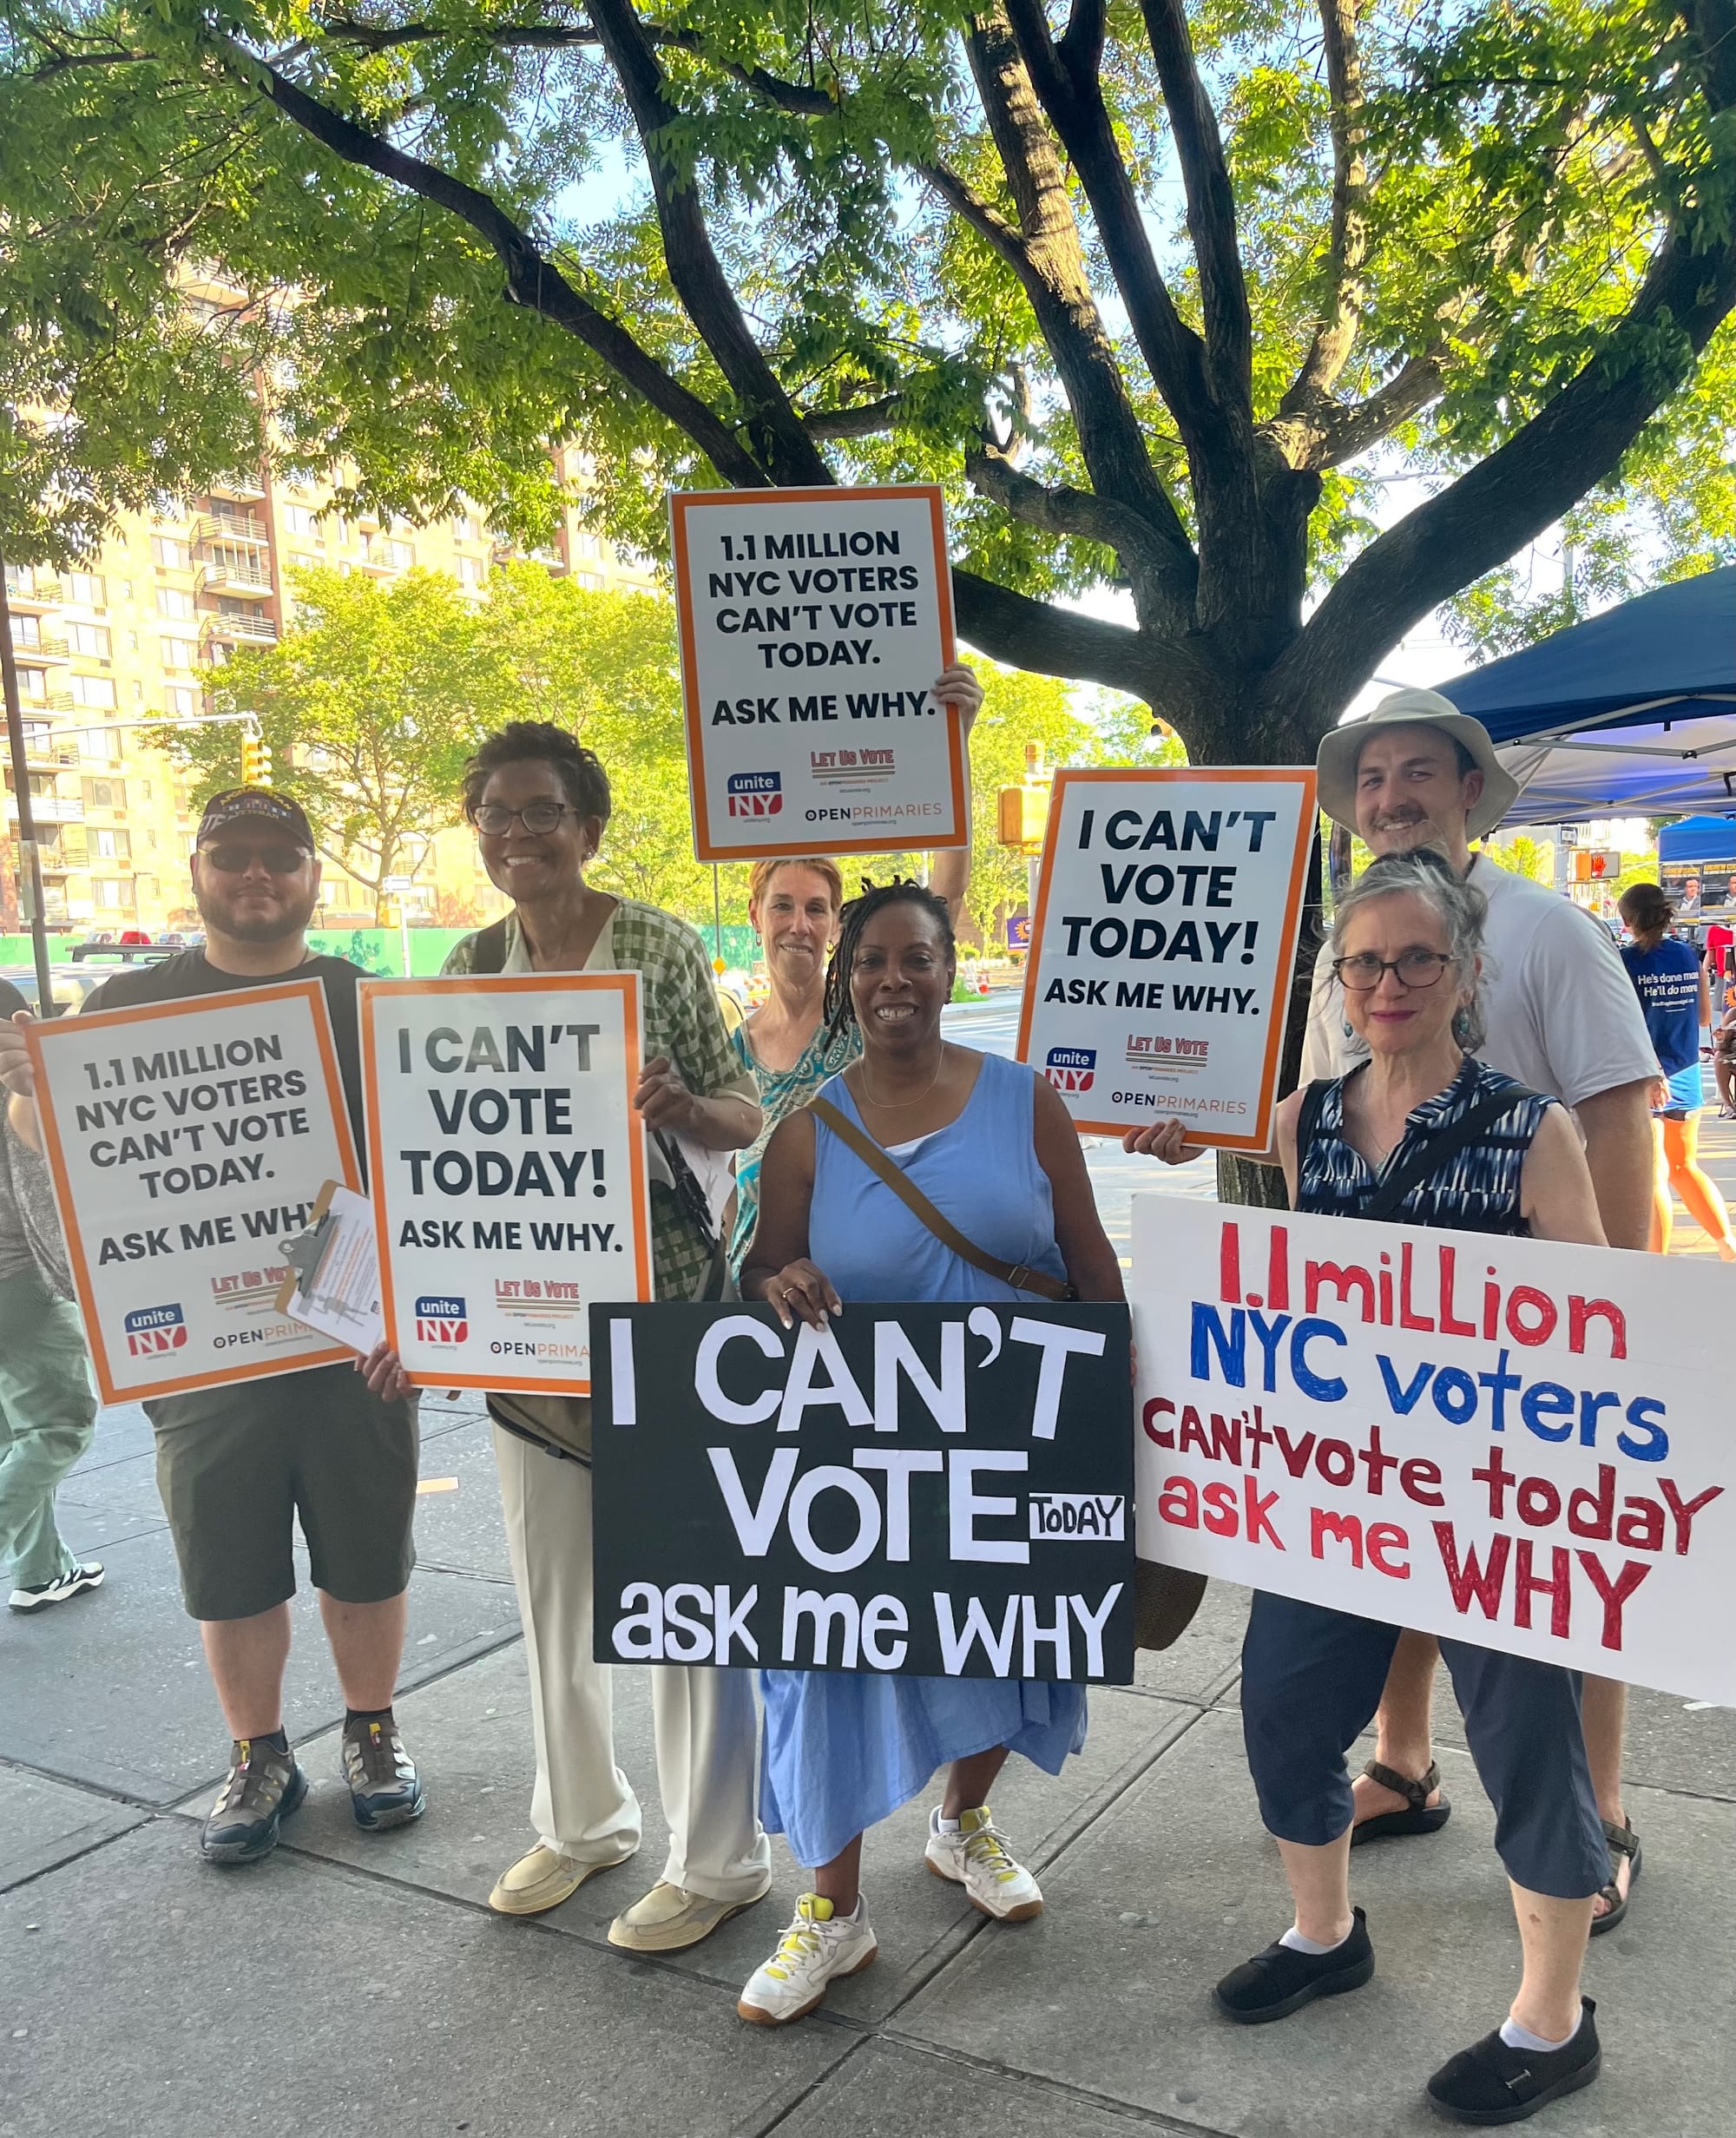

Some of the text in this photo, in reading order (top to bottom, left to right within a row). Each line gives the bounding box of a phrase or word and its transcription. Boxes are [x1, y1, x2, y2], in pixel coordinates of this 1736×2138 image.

[720, 530, 900, 561] 1.1 MILLION
[708, 565, 918, 598] NYC VOTERS
[716, 602, 917, 634] CAN'T VOTE
[758, 640, 881, 668] TODAY.
[711, 690, 936, 726] ASK ME WHY.
[733, 776, 775, 790] unite
[731, 793, 782, 817] NY
[805, 802, 943, 821] OPENPRIMARIES
[1078, 810, 1276, 852] I CAN'T
[1101, 864, 1237, 908] VOTE
[1062, 916, 1259, 965] TODAY!
[1044, 977, 1260, 1015] ASK ME WHY.
[1637, 973, 1659, 985] He's
[1644, 985, 1667, 997] He'll
[1667, 984, 1680, 995] do
[83, 1034, 282, 1090] 1.1 MILLION
[398, 1023, 601, 1074] I CAN'T
[1052, 1051, 1090, 1065] unite
[1047, 1069, 1093, 1091] NY
[76, 1069, 307, 1131] NYC VOTERS
[428, 1088, 573, 1135] VOTE
[1111, 1090, 1247, 1115] OPENPRIMARIES
[89, 1107, 310, 1168] CAN'T VOTE
[139, 1153, 275, 1199] TODAY.
[399, 1148, 608, 1198] TODAY!
[98, 1227, 174, 1266] ASK
[181, 1216, 236, 1250] ME
[398, 1220, 623, 1253] ASK ME WHY.
[132, 1310, 176, 1328] unite
[420, 1300, 460, 1315] unite
[129, 1326, 186, 1355] NY
[418, 1319, 465, 1343] NY
[609, 1306, 1107, 1441] I CAN'T
[1190, 1300, 1669, 1462] NYC voters
[1272, 1424, 1445, 1507] vote
[706, 1447, 1030, 1573] VOTE
[1157, 1474, 1654, 1652] ask me WHY
[611, 1581, 1124, 1680] ask me WHY
